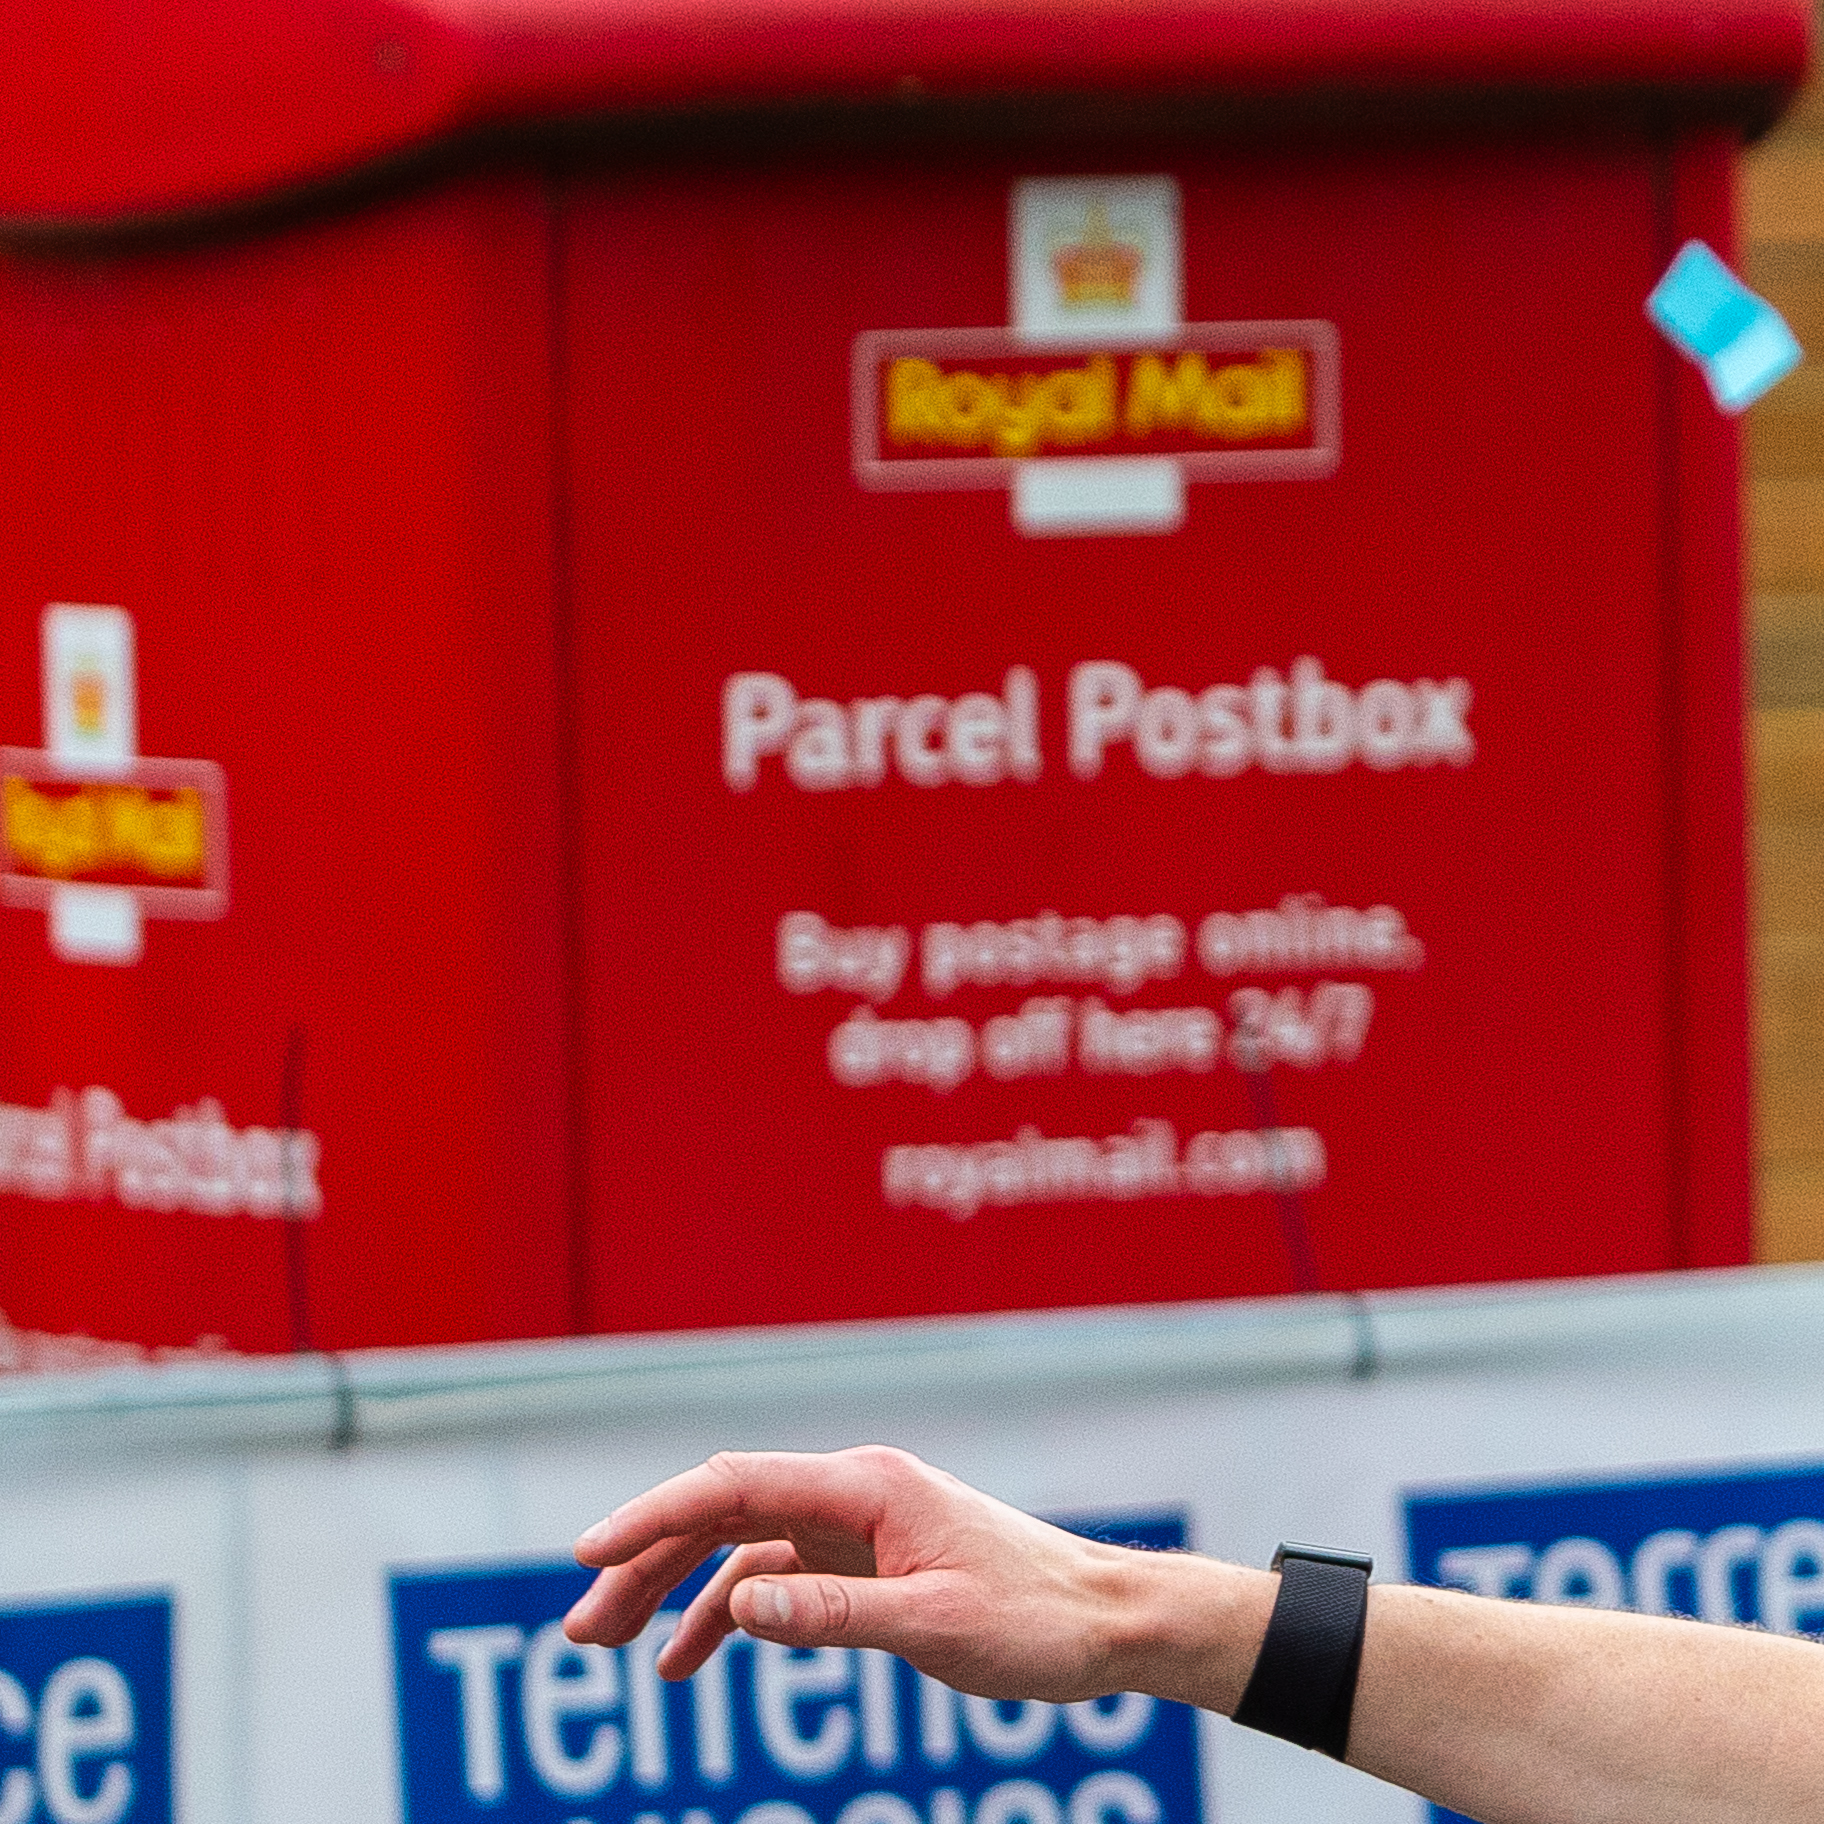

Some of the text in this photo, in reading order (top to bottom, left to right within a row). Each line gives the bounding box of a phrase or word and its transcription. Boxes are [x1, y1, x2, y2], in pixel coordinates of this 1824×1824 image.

[884, 346, 1309, 458] Royal Mail
[721, 654, 1476, 793] Parcel Postbox
